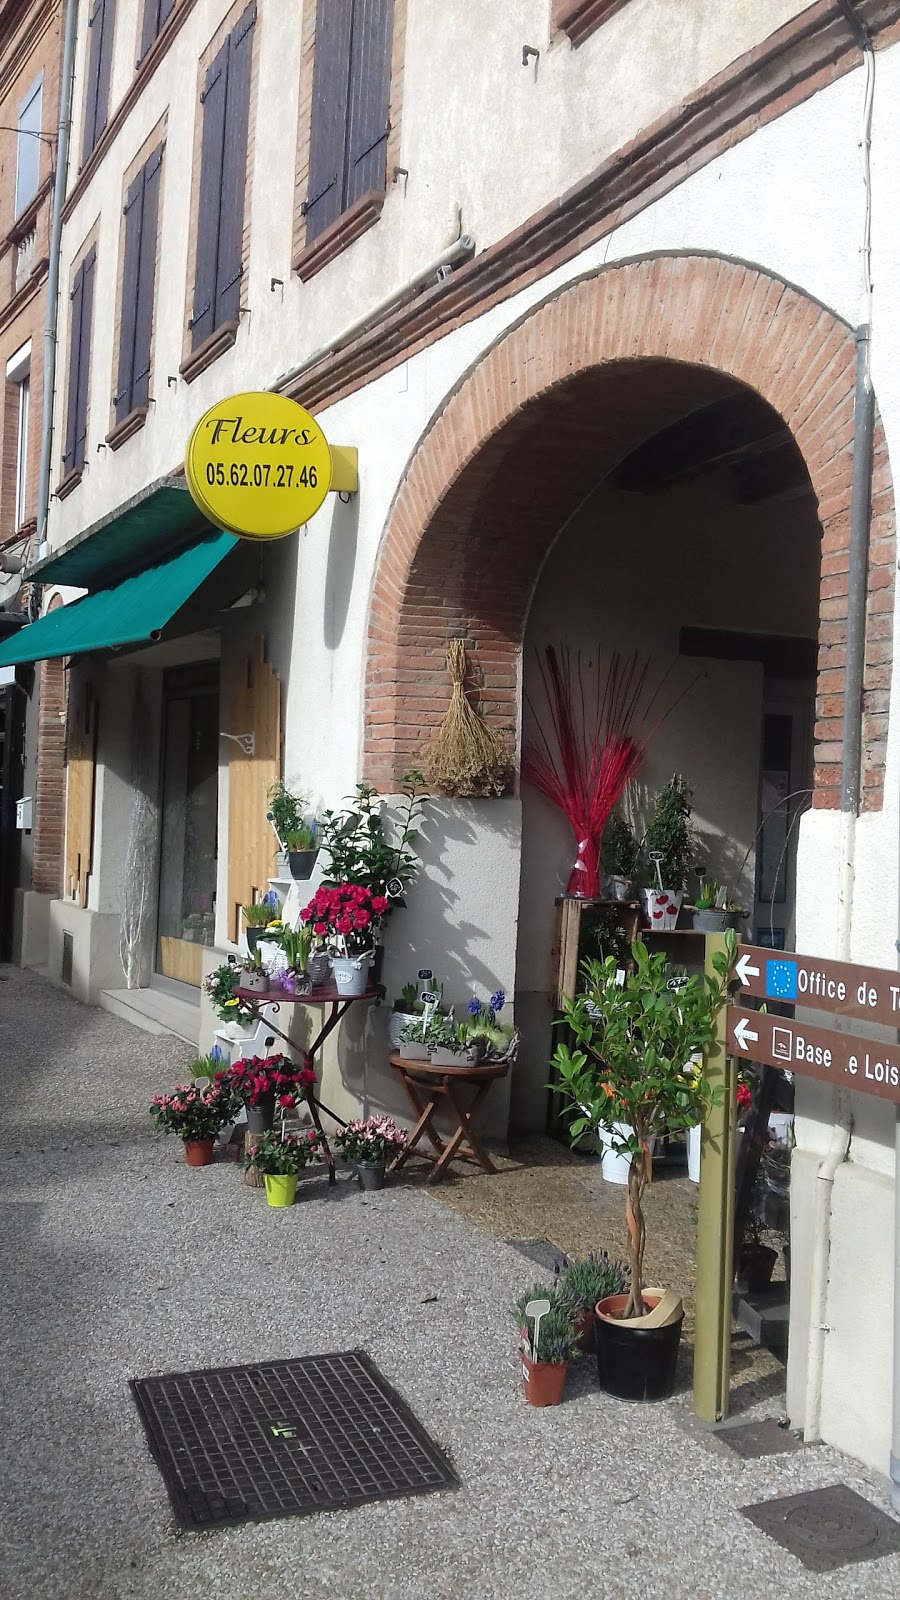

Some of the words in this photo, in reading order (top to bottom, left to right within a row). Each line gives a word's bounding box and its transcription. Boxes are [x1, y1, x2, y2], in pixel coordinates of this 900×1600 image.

[205, 416, 317, 446] Fleurs
[206, 462, 318, 489] 05.62.07.27.46
[797, 969, 846, 1000] Office
[857, 981, 878, 1007] de
[889, 986, 900, 1012] T
[795, 1036, 832, 1068] Base
